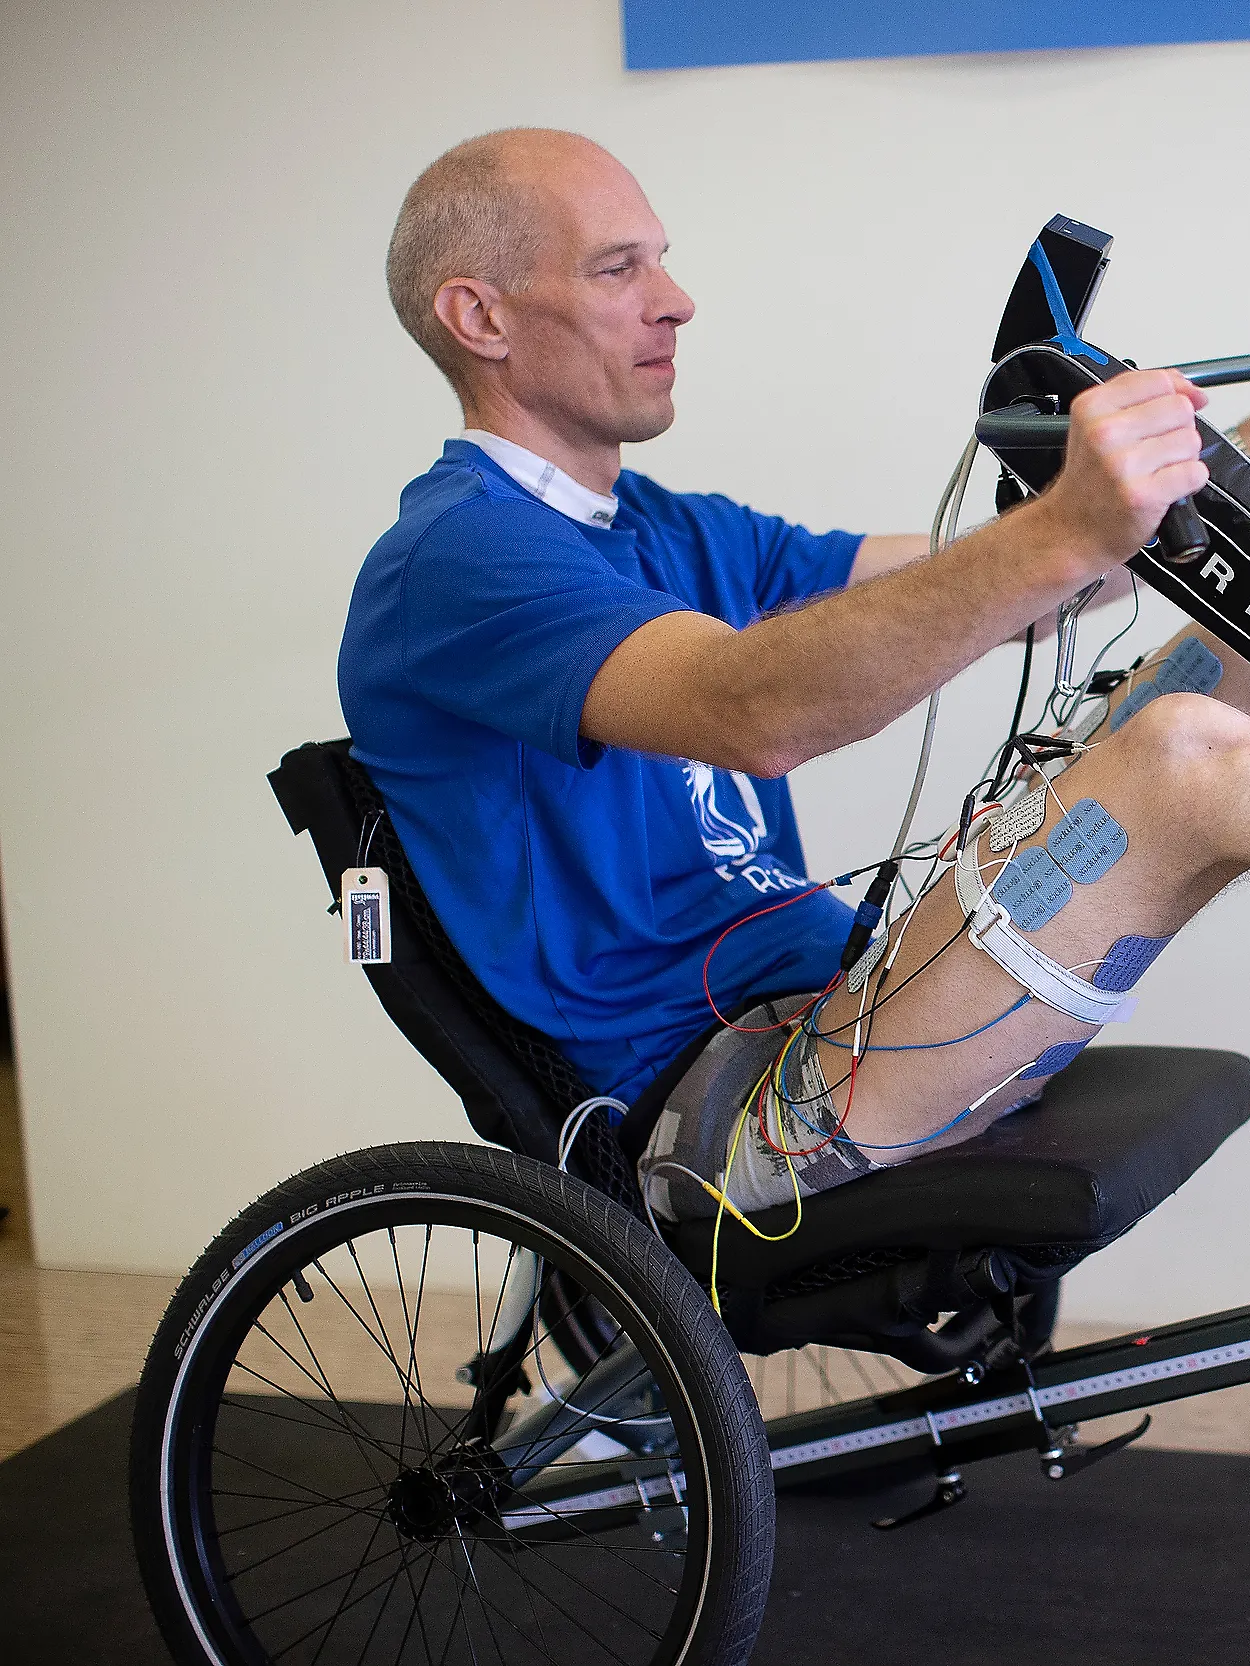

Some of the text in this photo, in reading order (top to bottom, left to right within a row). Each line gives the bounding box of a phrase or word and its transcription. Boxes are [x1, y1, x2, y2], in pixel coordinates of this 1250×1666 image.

[290, 1184, 385, 1225] BIG APPLE
[174, 1267, 230, 1360] SCHWALBE
